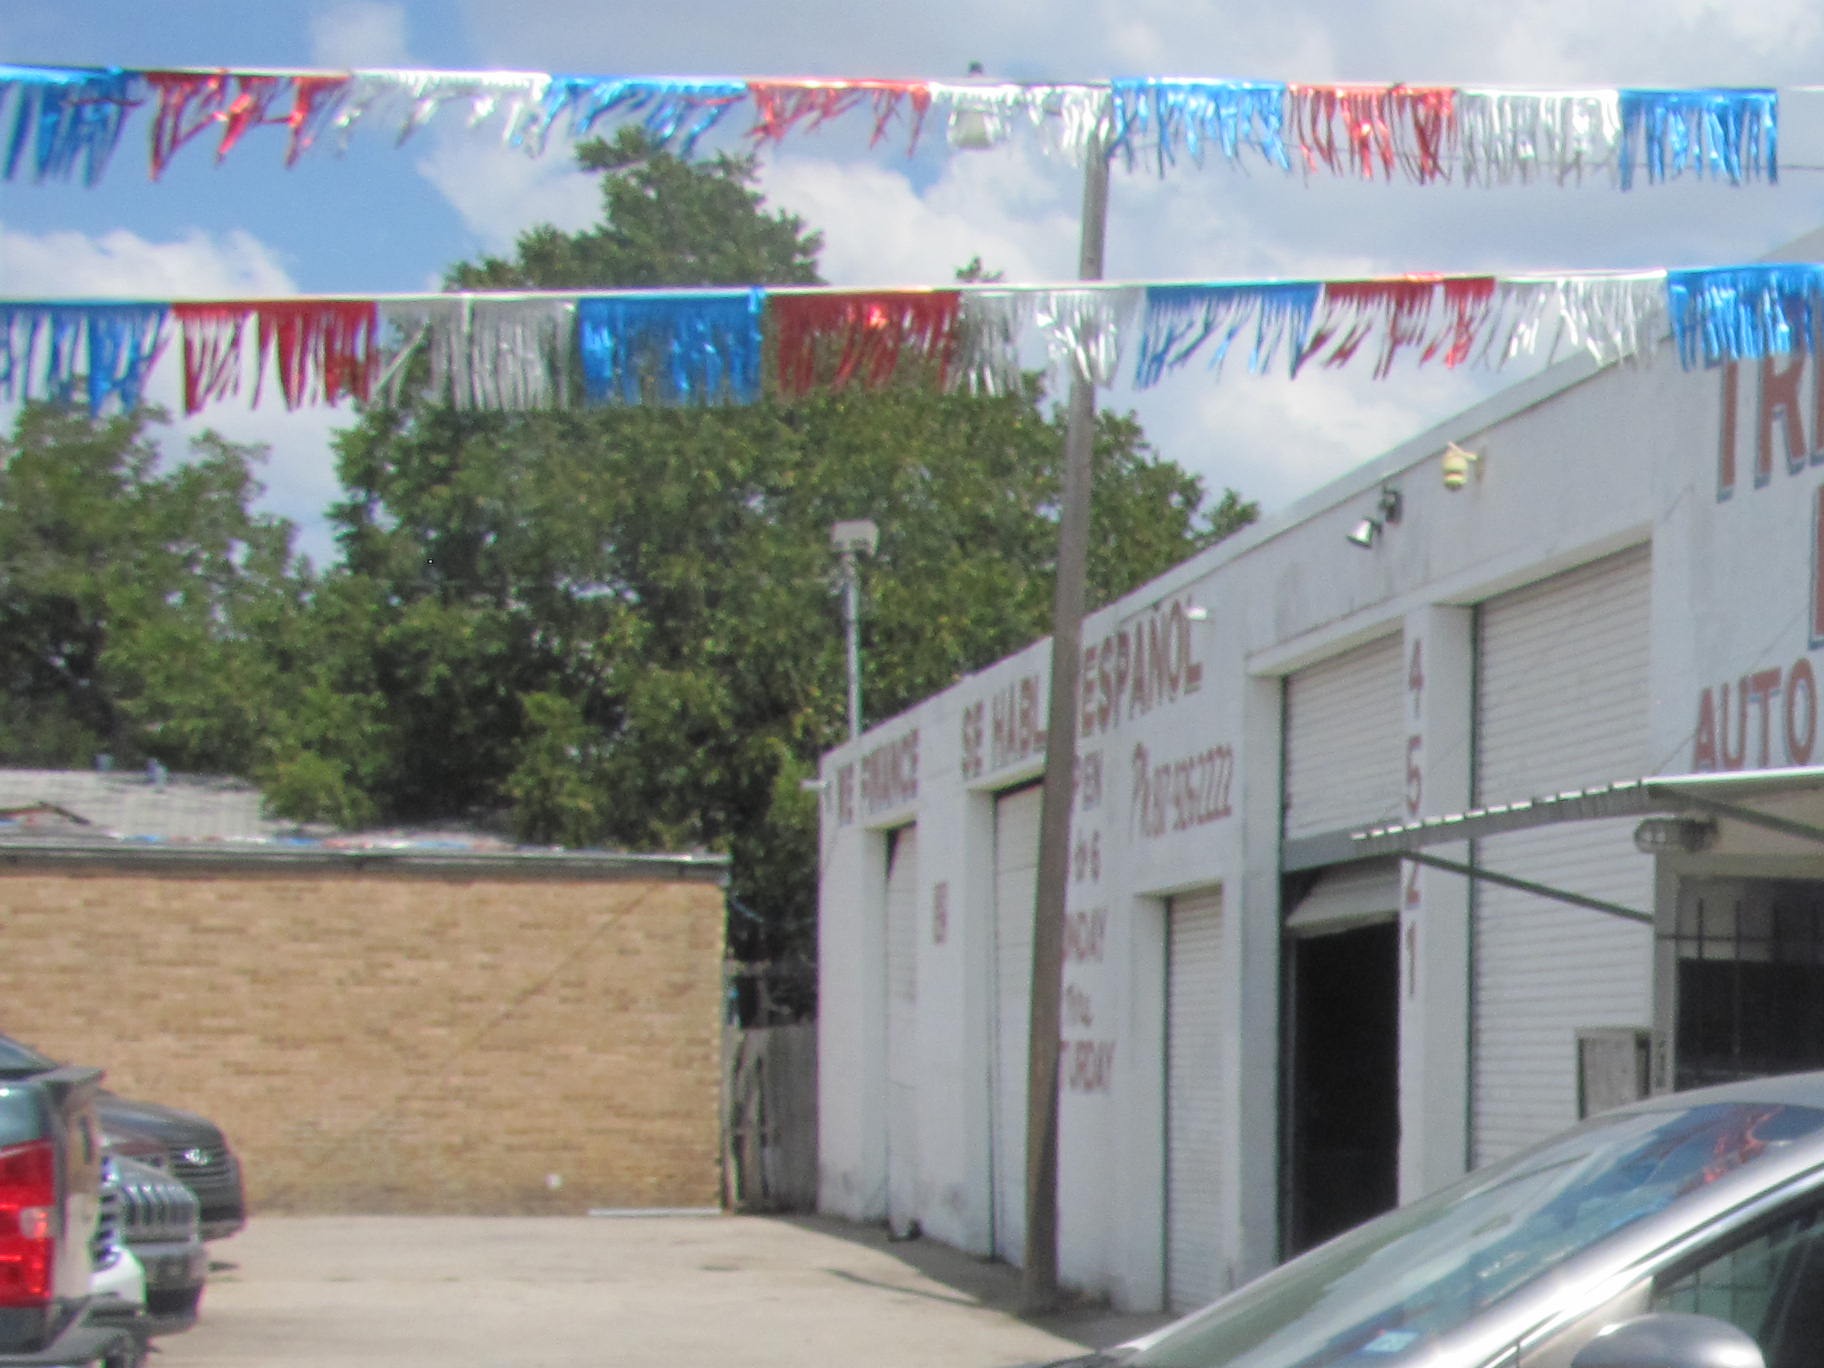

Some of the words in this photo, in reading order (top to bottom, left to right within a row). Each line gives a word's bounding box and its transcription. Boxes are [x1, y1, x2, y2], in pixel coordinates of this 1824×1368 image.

[992, 675, 1049, 770] HABL
[1080, 597, 1204, 738] ESPAÑOL
[1692, 657, 1818, 774] AUTO
